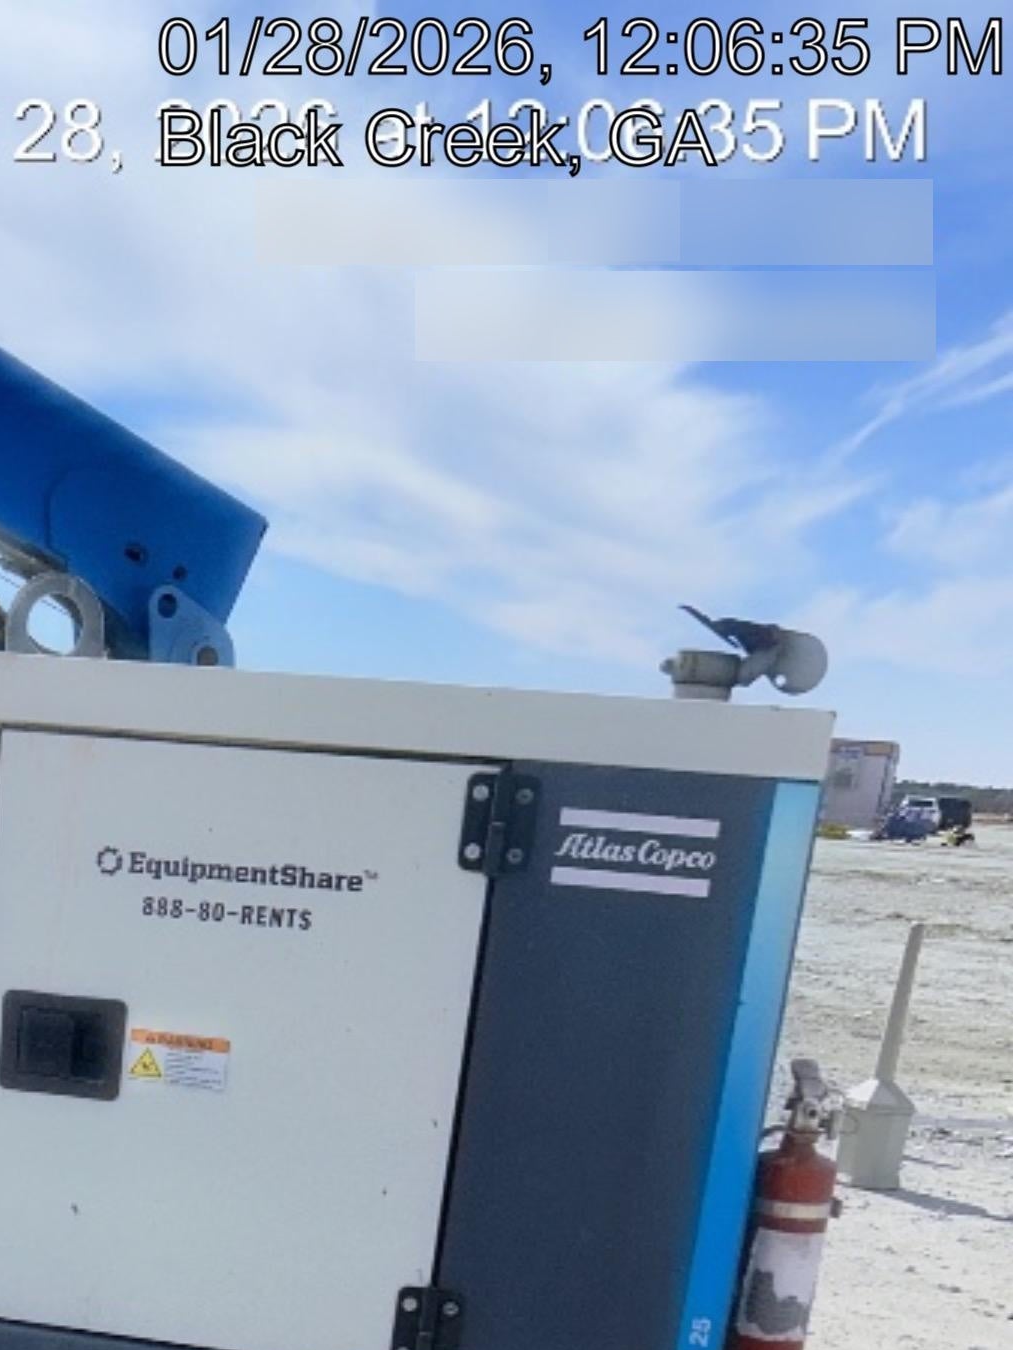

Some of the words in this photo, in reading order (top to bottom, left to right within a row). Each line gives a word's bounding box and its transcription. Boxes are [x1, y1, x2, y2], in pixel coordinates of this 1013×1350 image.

[555, 833, 636, 862] Atlas
[638, 839, 717, 871] Copco
[141, 896, 313, 931] 888-80-RENTS
